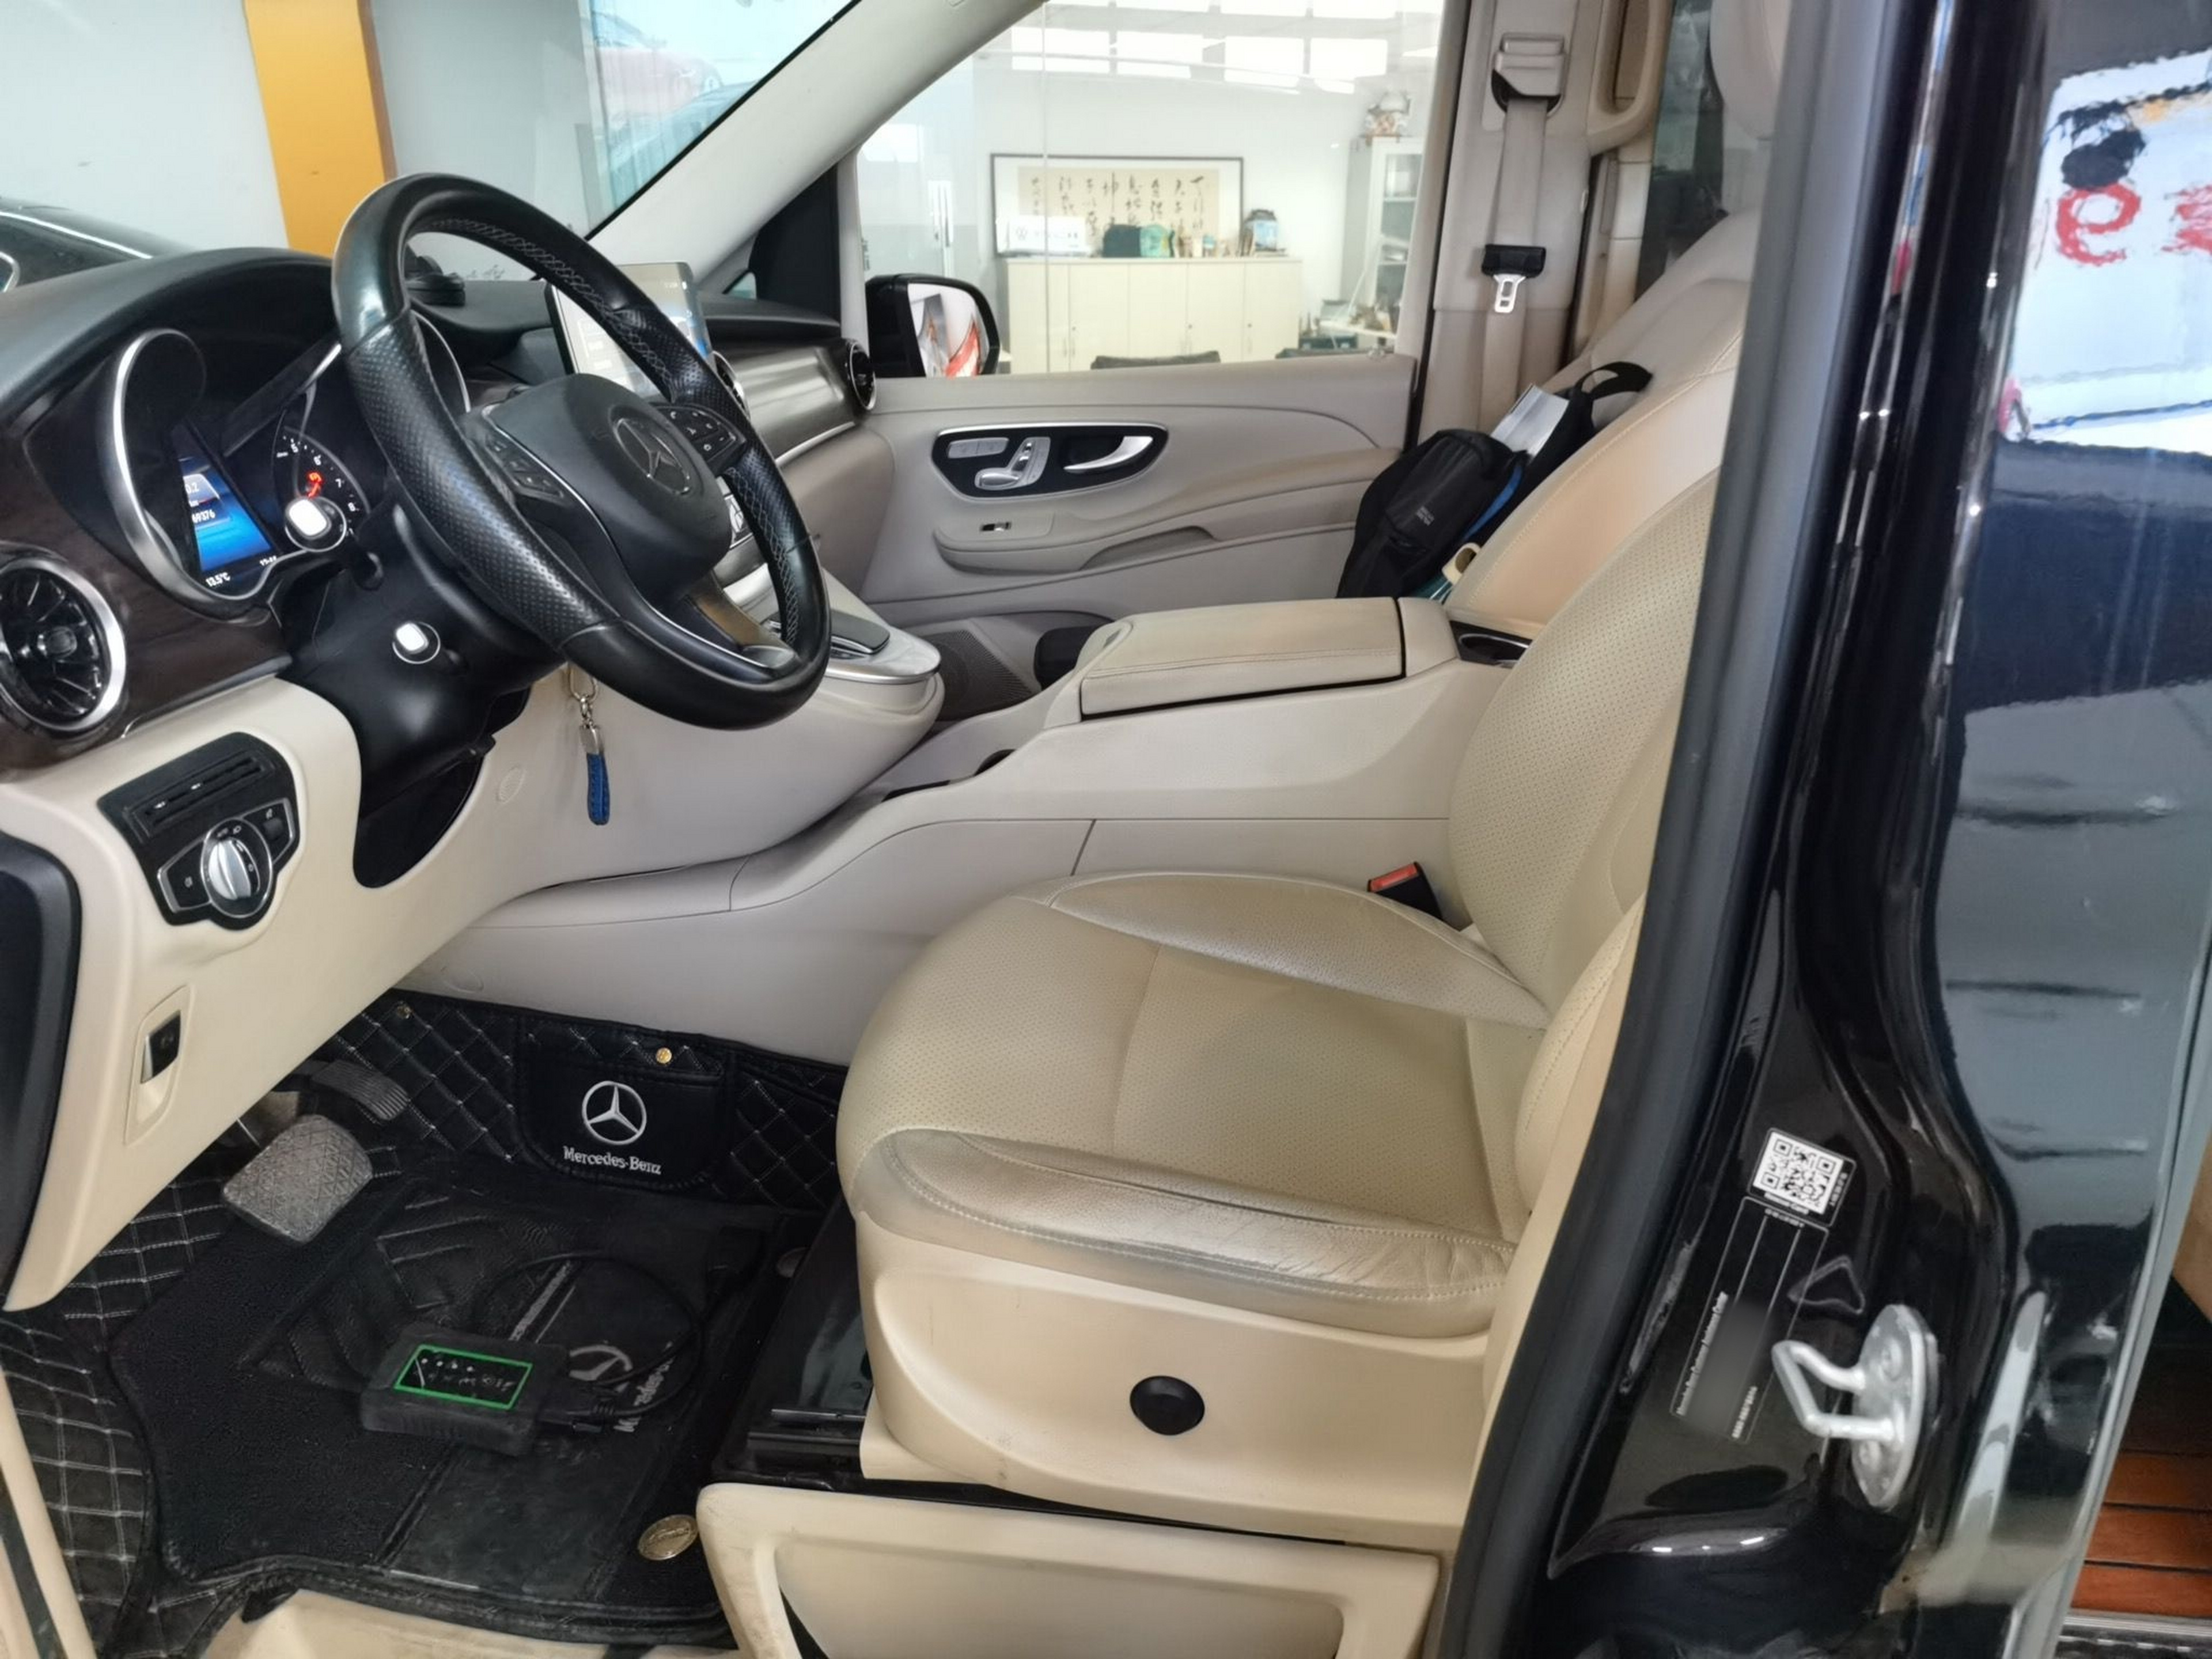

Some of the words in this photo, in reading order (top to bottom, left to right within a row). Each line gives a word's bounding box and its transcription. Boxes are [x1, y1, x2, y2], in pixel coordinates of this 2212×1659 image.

[290, 443, 299, 453] 5
[313, 456, 321, 466] 6
[335, 478, 342, 488] 7
[347, 502, 357, 512] 8
[562, 1145, 662, 1175] Mercedes-Benz
